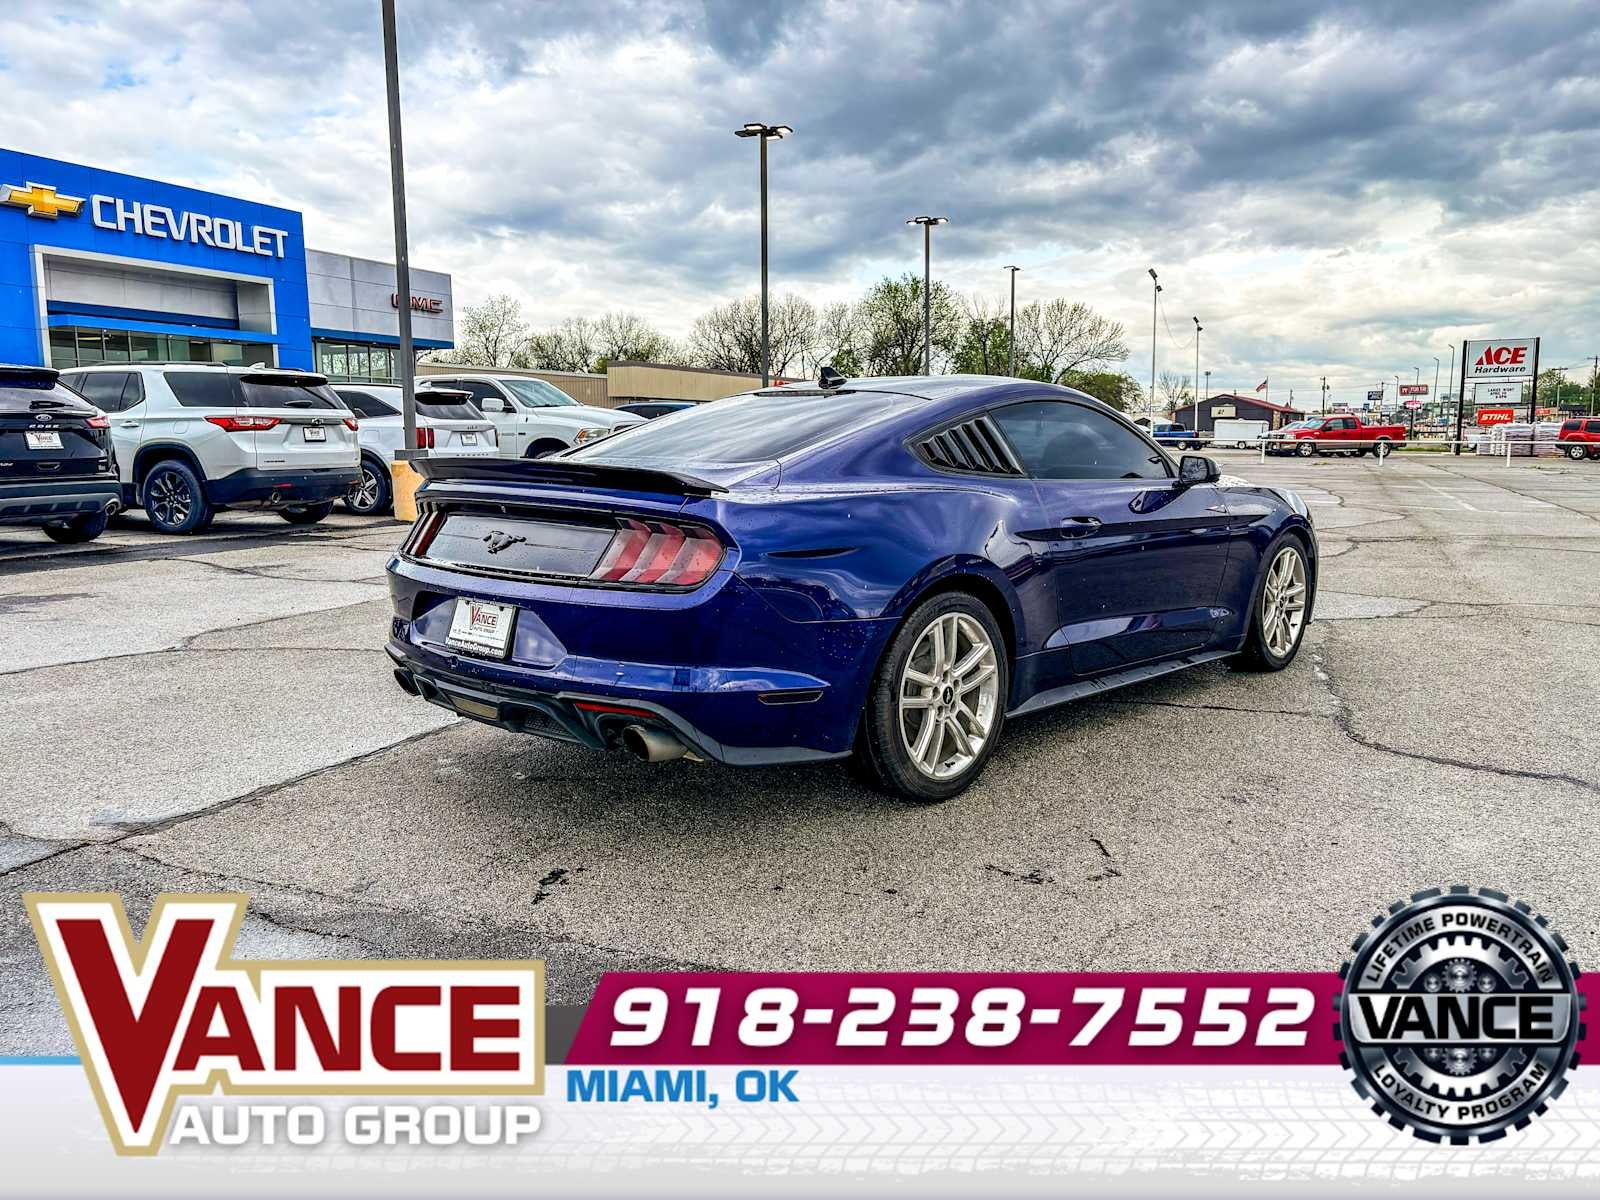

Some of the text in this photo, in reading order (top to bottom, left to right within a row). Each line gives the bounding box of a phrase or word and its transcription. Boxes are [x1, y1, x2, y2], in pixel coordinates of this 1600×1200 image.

[91, 194, 289, 258] CHEVROLET
[1475, 345, 1528, 365] ACE
[1475, 366, 1526, 374] Hardware
[1481, 413, 1511, 421] STIHL
[471, 605, 497, 626] VANCE
